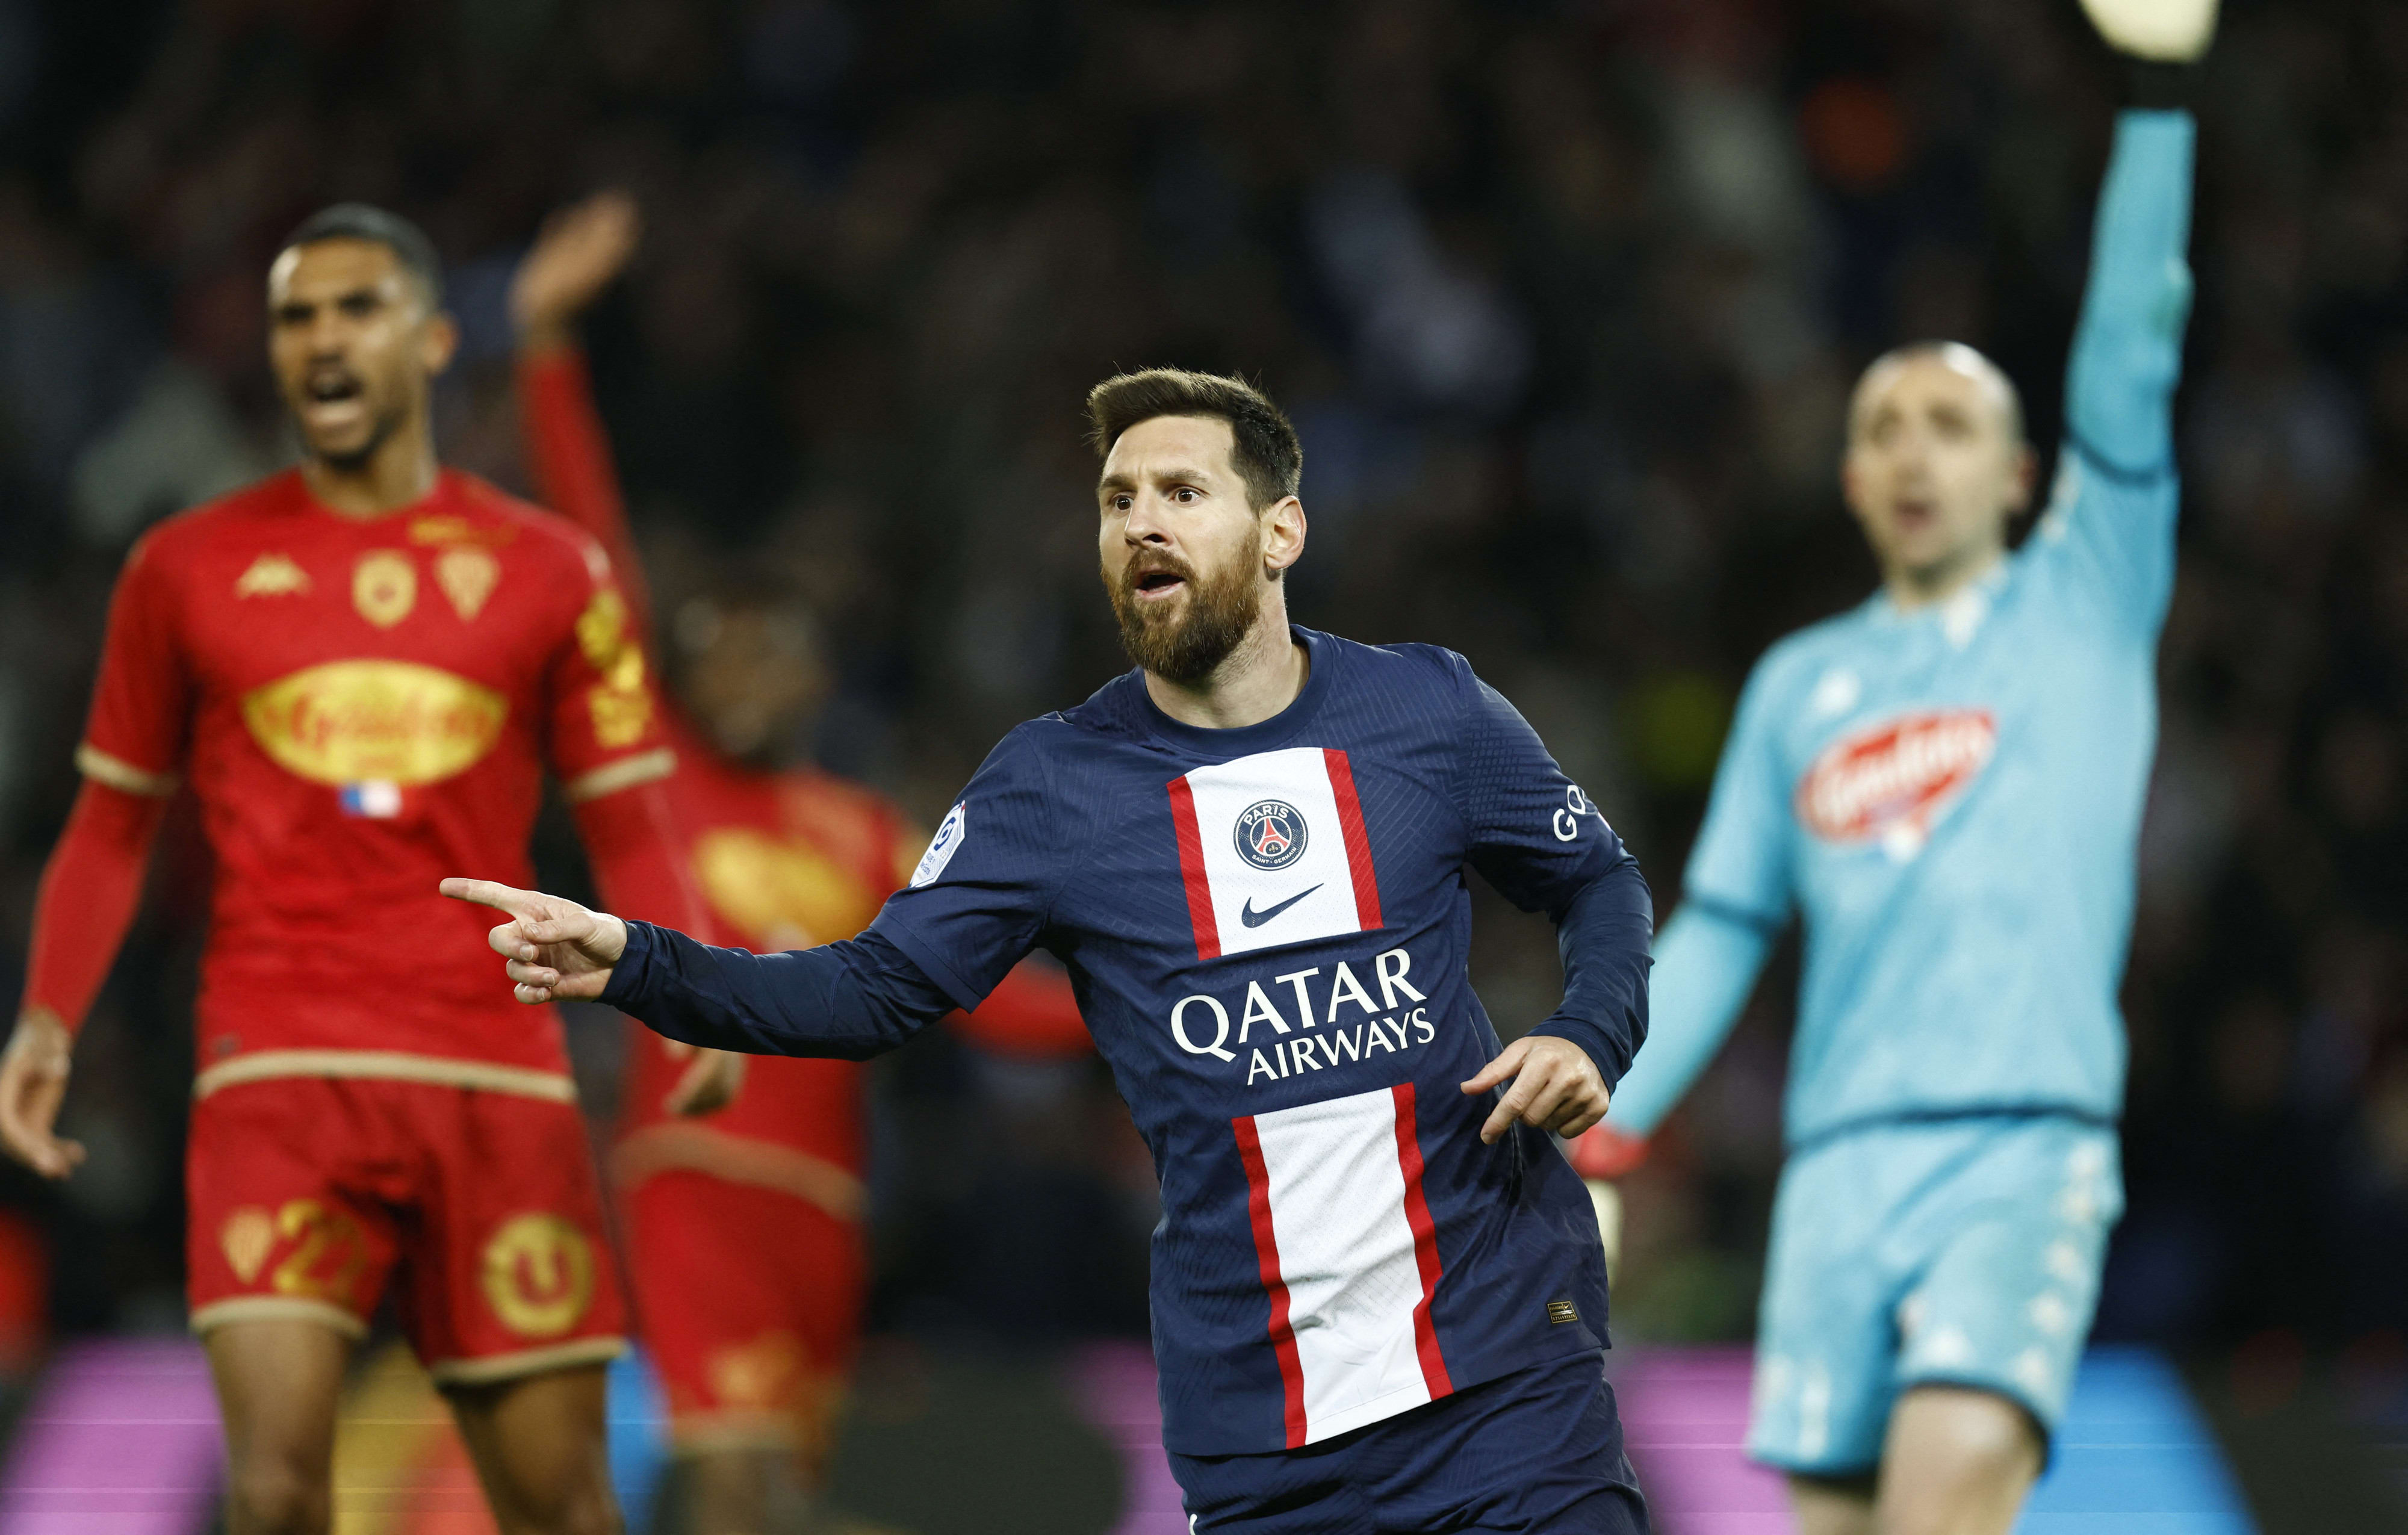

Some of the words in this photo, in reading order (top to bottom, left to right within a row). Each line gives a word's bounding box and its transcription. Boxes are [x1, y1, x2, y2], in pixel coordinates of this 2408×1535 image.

[1243, 805, 1289, 825] PARIS
[1252, 854, 1269, 864] SAINT
[1274, 846, 1297, 864] GERMAIN
[1171, 949, 1427, 1062] QATAR
[1247, 1008, 1435, 1085] AIRWAYS
